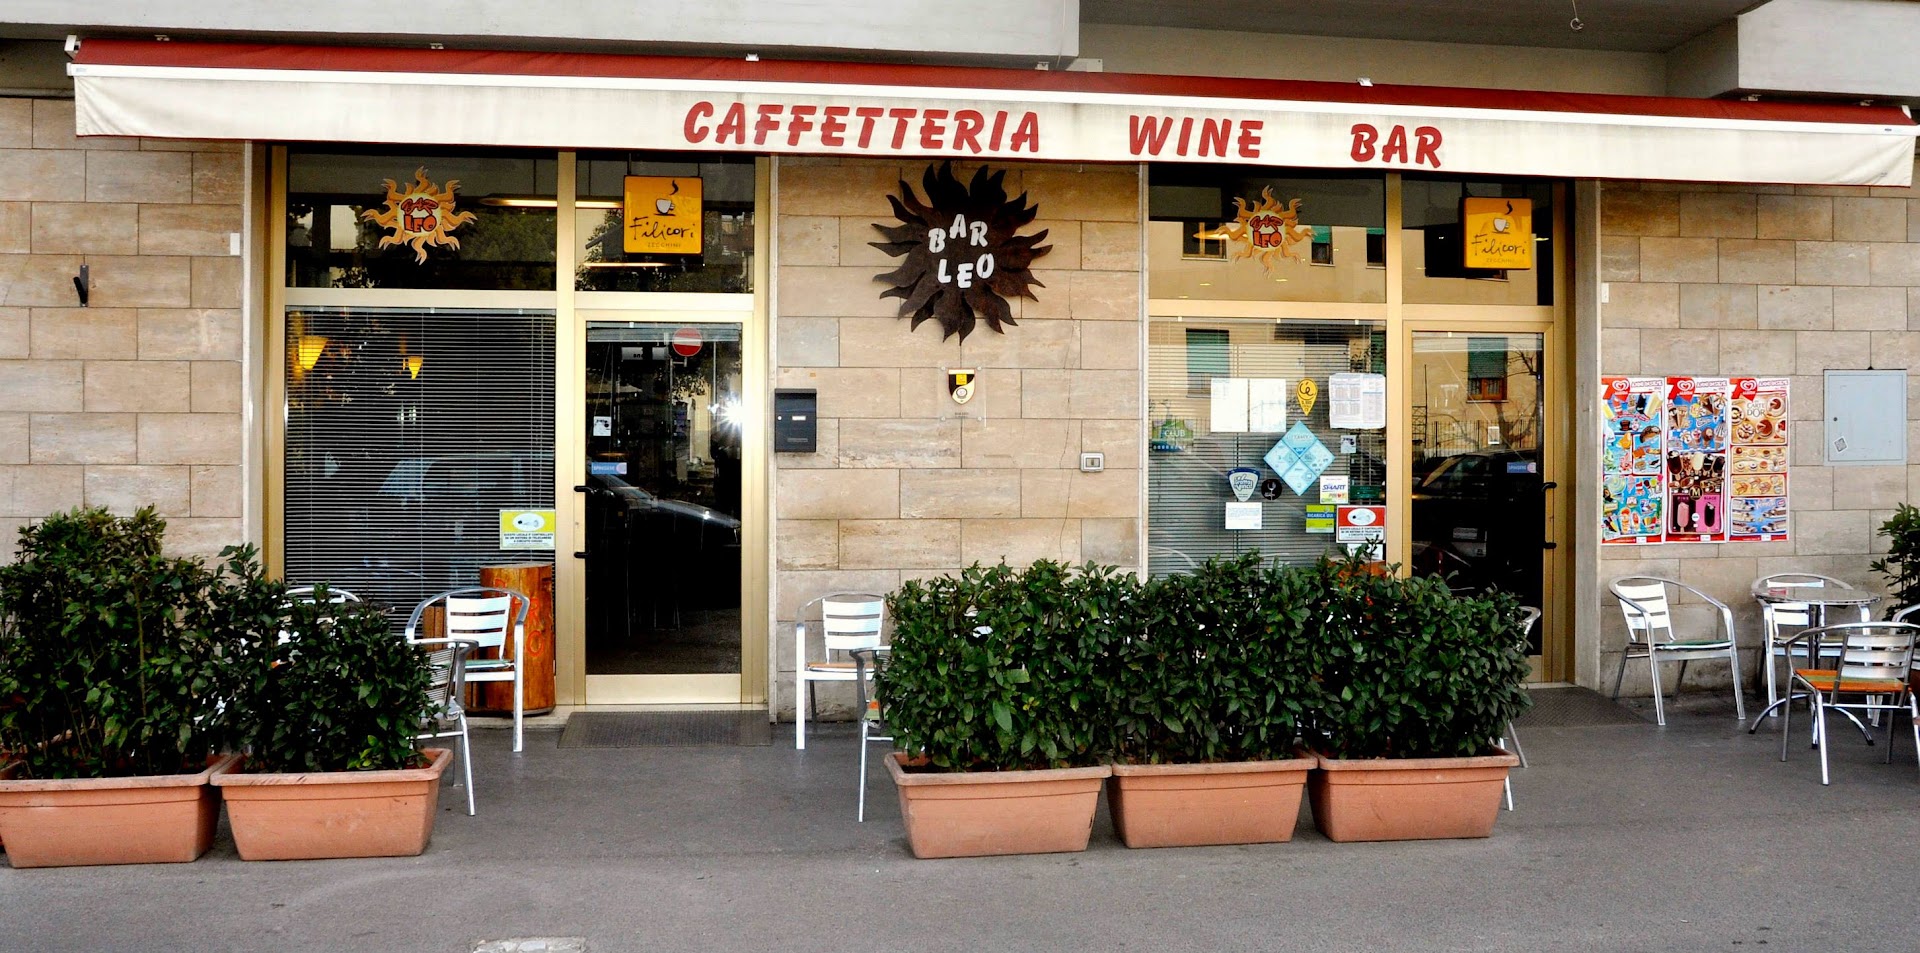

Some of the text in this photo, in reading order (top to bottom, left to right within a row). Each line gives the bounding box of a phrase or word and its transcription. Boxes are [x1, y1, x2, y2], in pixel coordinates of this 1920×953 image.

[684, 101, 1443, 168] CAFFETTERIA WINE BAR
[401, 197, 439, 215] BAR
[404, 214, 437, 233] LEO
[629, 216, 696, 240] Filicori
[928, 213, 989, 253] BAR
[1250, 215, 1283, 232] BAR
[1253, 230, 1283, 248] LEO
[1471, 234, 1527, 256] Filicori
[938, 253, 995, 288] LEO
[1165, 429, 1186, 437] CLUB
